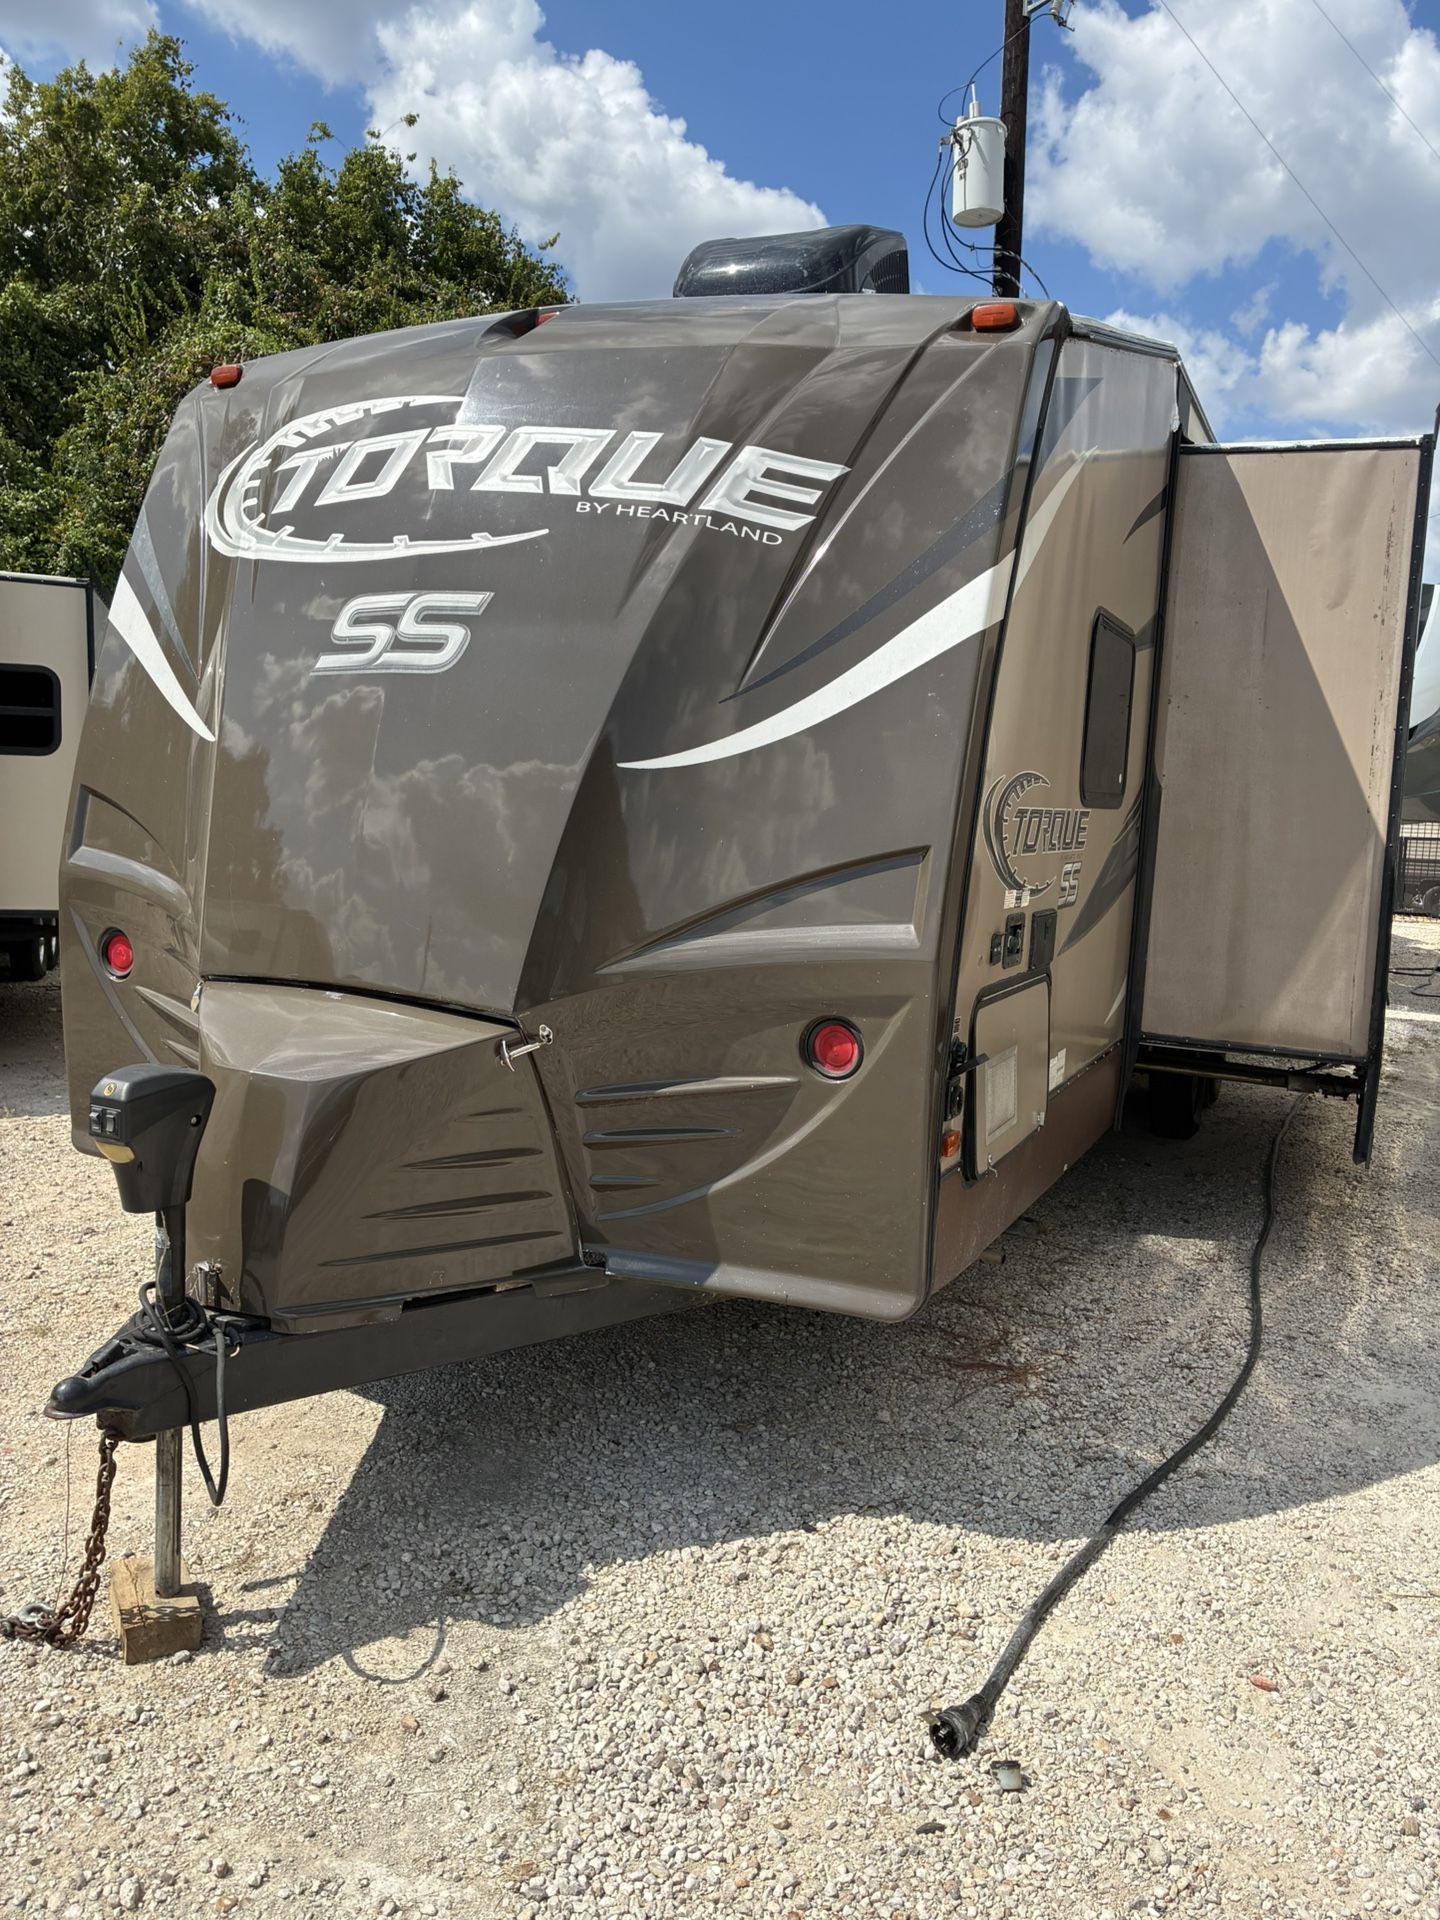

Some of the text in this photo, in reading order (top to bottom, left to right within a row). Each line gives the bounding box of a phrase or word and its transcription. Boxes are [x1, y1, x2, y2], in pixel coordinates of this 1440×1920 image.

[271, 425, 852, 531] TORQUE
[575, 501, 783, 545] BY HEARTLAND
[310, 591, 495, 675] SS
[1012, 807, 1091, 857] TORQUE
[1056, 860, 1082, 910] SS
